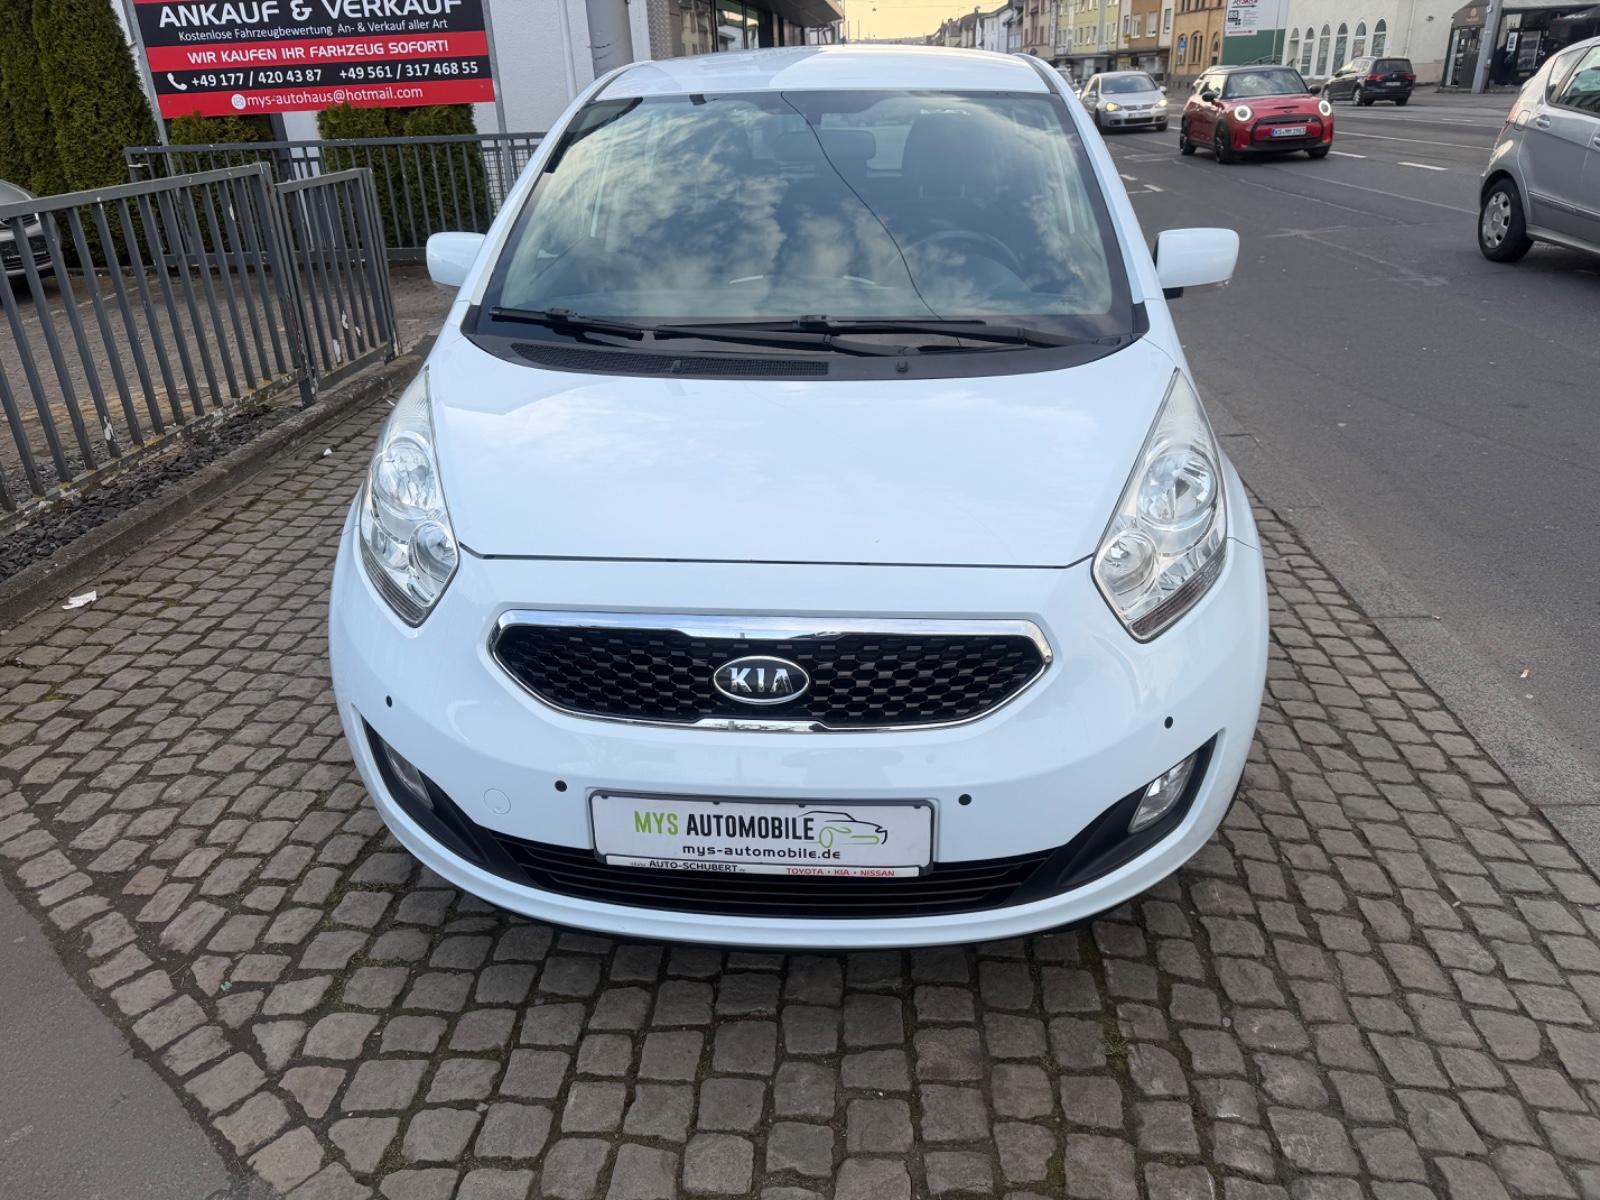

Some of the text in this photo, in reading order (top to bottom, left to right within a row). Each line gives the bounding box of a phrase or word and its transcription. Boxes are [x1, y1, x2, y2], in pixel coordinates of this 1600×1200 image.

[160, 0, 461, 27] ANKAUF & VERKAUF
[179, 29, 232, 41] Kostenlose
[235, 26, 333, 39] Fahrzeugbewertung
[357, 22, 366, 32] &
[367, 20, 406, 31] Verkauf
[408, 20, 430, 30] aller
[432, 19, 448, 29] Art
[187, 40, 449, 64] WIR KAUFEN IHR FARHZEUG SOFORT!
[192, 61, 478, 87] +49 177 / 420 43 87 +49 561 / 317 468 55
[247, 87, 423, 107] mys-autohaus@hotmail.com
[729, 667, 794, 694] KIA
[634, 810, 815, 841] MYS AUTOMOBILE
[682, 845, 841, 859] mys-automobile.de
[650, 860, 737, 871] AUTO-SCHUBERT
[786, 867, 824, 876] TOYOTA
[834, 868, 850, 876] KIA
